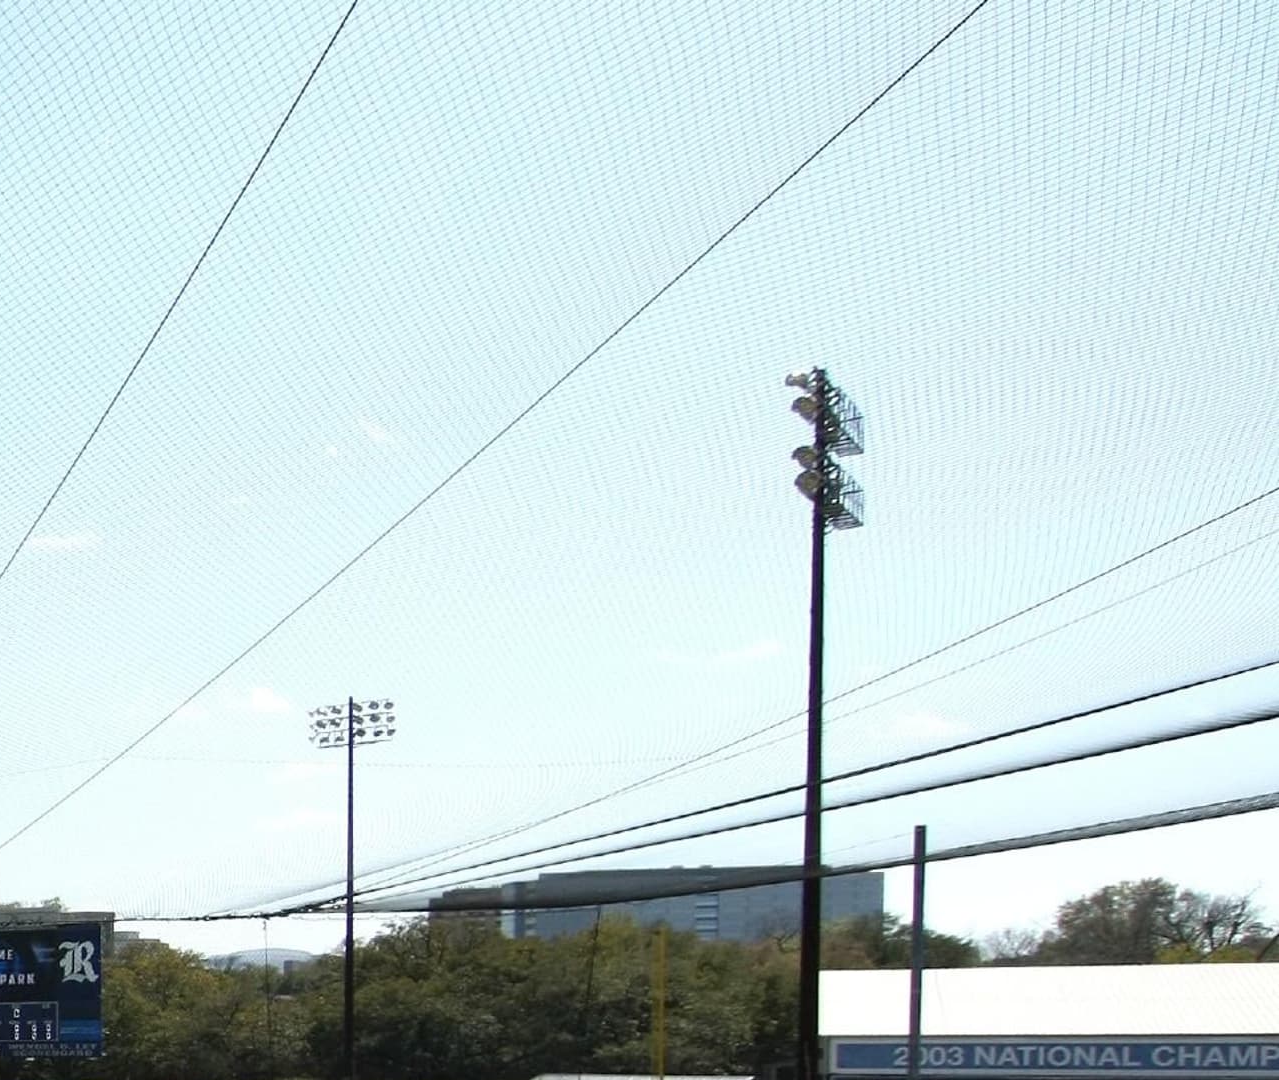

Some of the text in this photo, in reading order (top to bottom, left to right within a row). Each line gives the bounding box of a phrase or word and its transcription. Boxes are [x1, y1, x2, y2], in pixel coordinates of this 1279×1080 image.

[0, 973, 36, 986] PARK
[973, 1045, 1141, 1068] NATIONAL
[1150, 1044, 1279, 1068] CHAMP
